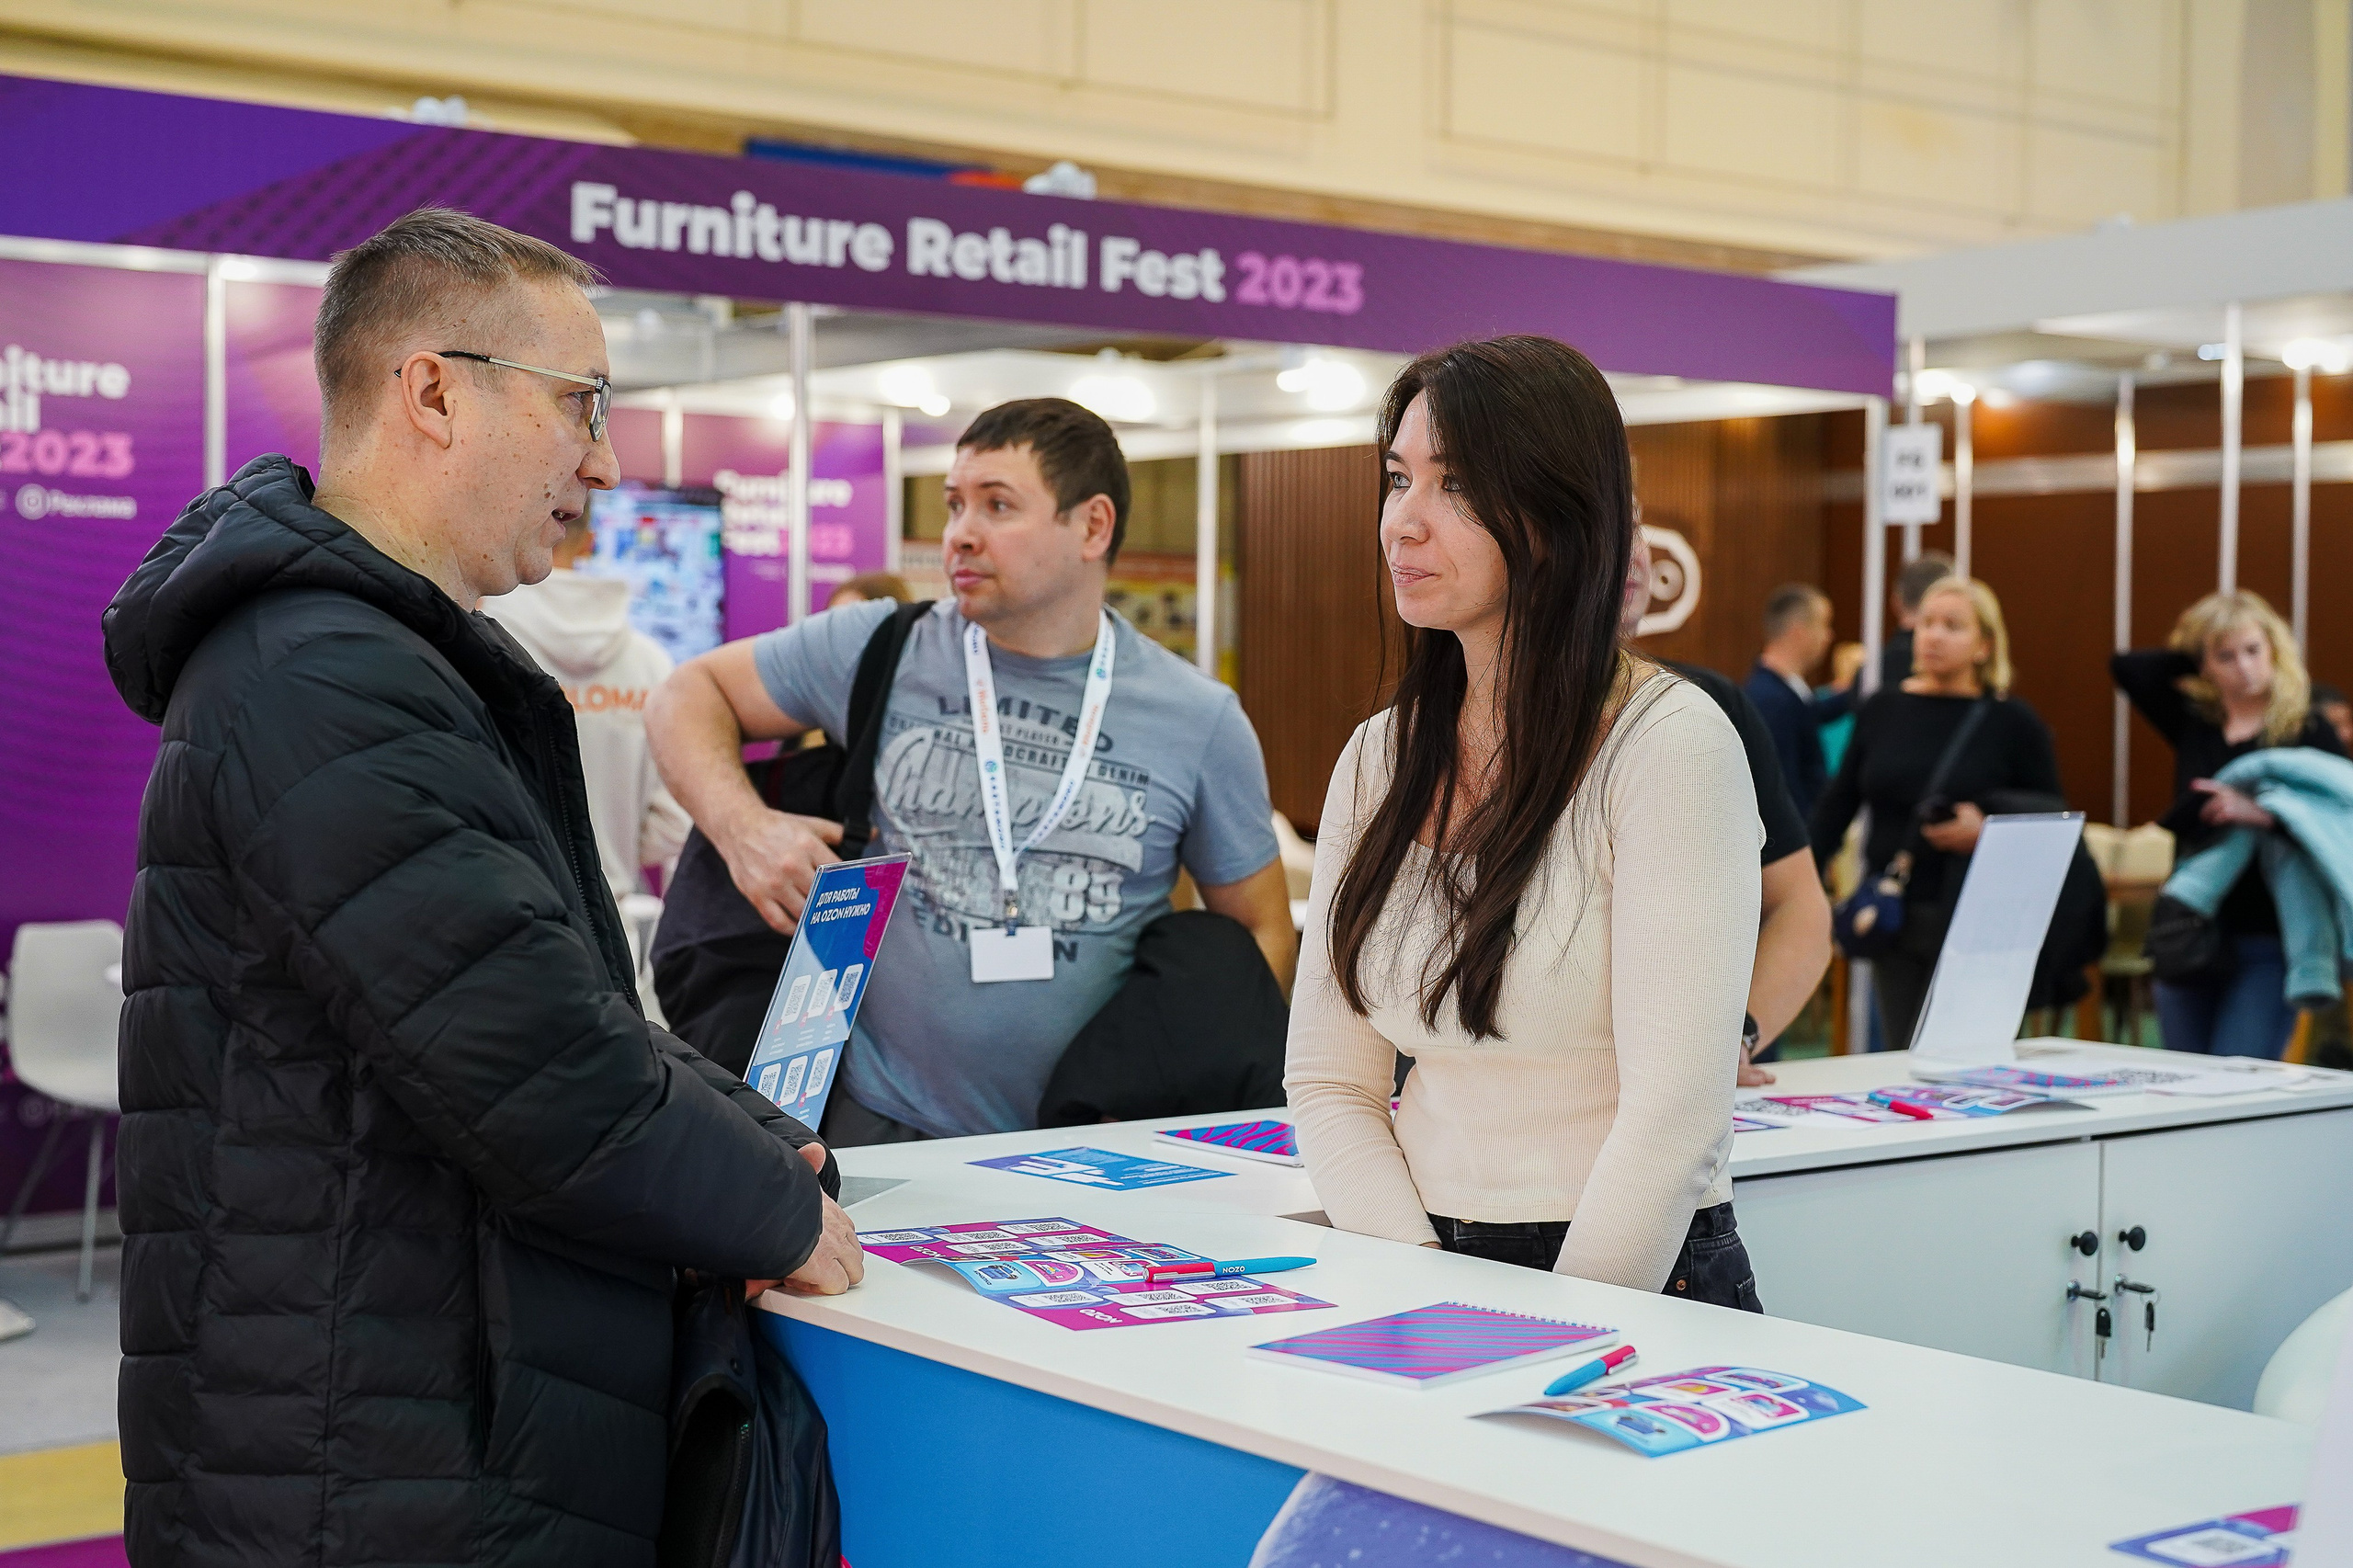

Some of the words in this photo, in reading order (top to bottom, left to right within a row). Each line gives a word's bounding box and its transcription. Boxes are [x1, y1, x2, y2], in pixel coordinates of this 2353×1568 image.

[570, 179, 895, 272] Furniture
[906, 215, 1089, 290] Retail
[1099, 234, 1228, 303] Fest
[1235, 249, 1366, 316] 2023
[0, 428, 136, 480] 2023
[810, 911, 822, 926] НА
[821, 906, 845, 923] OZON
[843, 903, 871, 920] НУЖНО
[816, 892, 833, 908] ДЛЯ
[831, 887, 861, 903] РАБОТЫ
